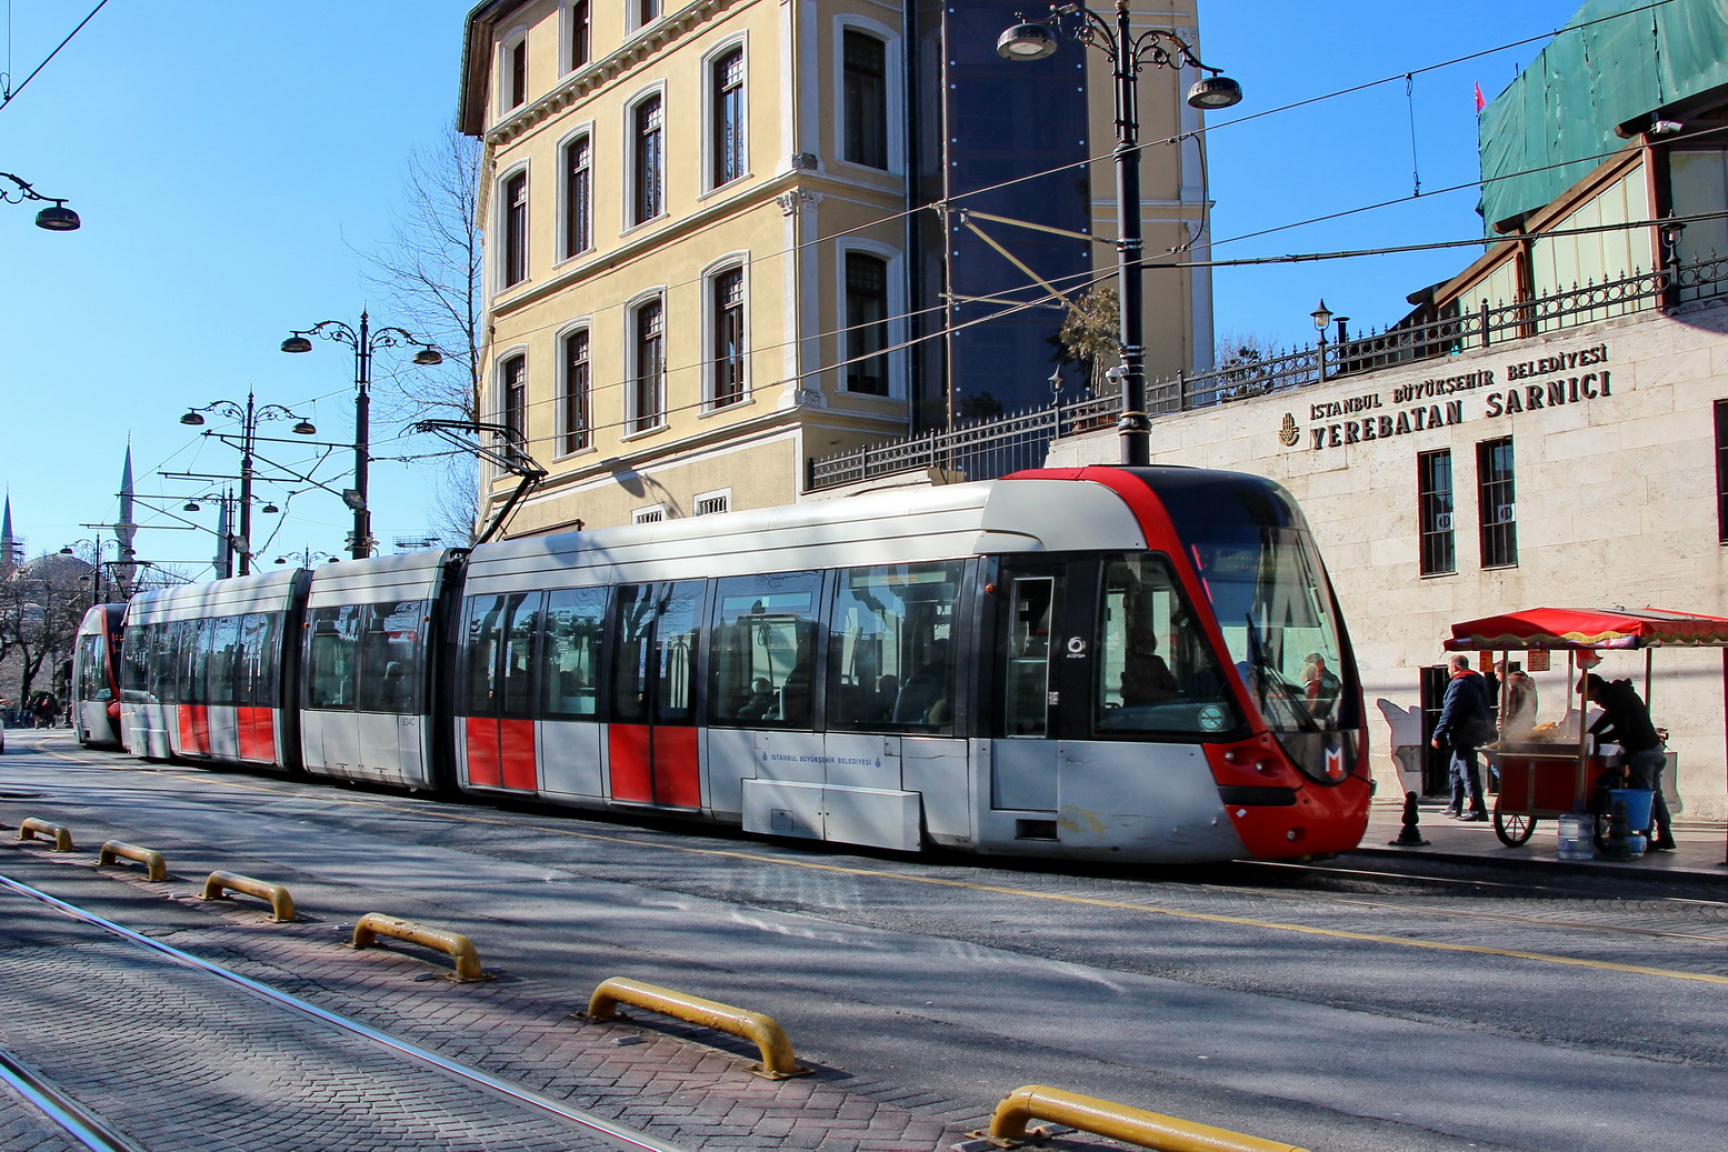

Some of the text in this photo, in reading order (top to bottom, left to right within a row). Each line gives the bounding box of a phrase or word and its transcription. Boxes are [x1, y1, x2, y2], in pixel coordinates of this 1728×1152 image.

[1309, 343, 1608, 421] İSTANBUL BÜYÜKŞEHİR BELEDİYESİ
[1310, 370, 1612, 450] YEREBATAN SARNICI
[1325, 747, 1343, 772] M
